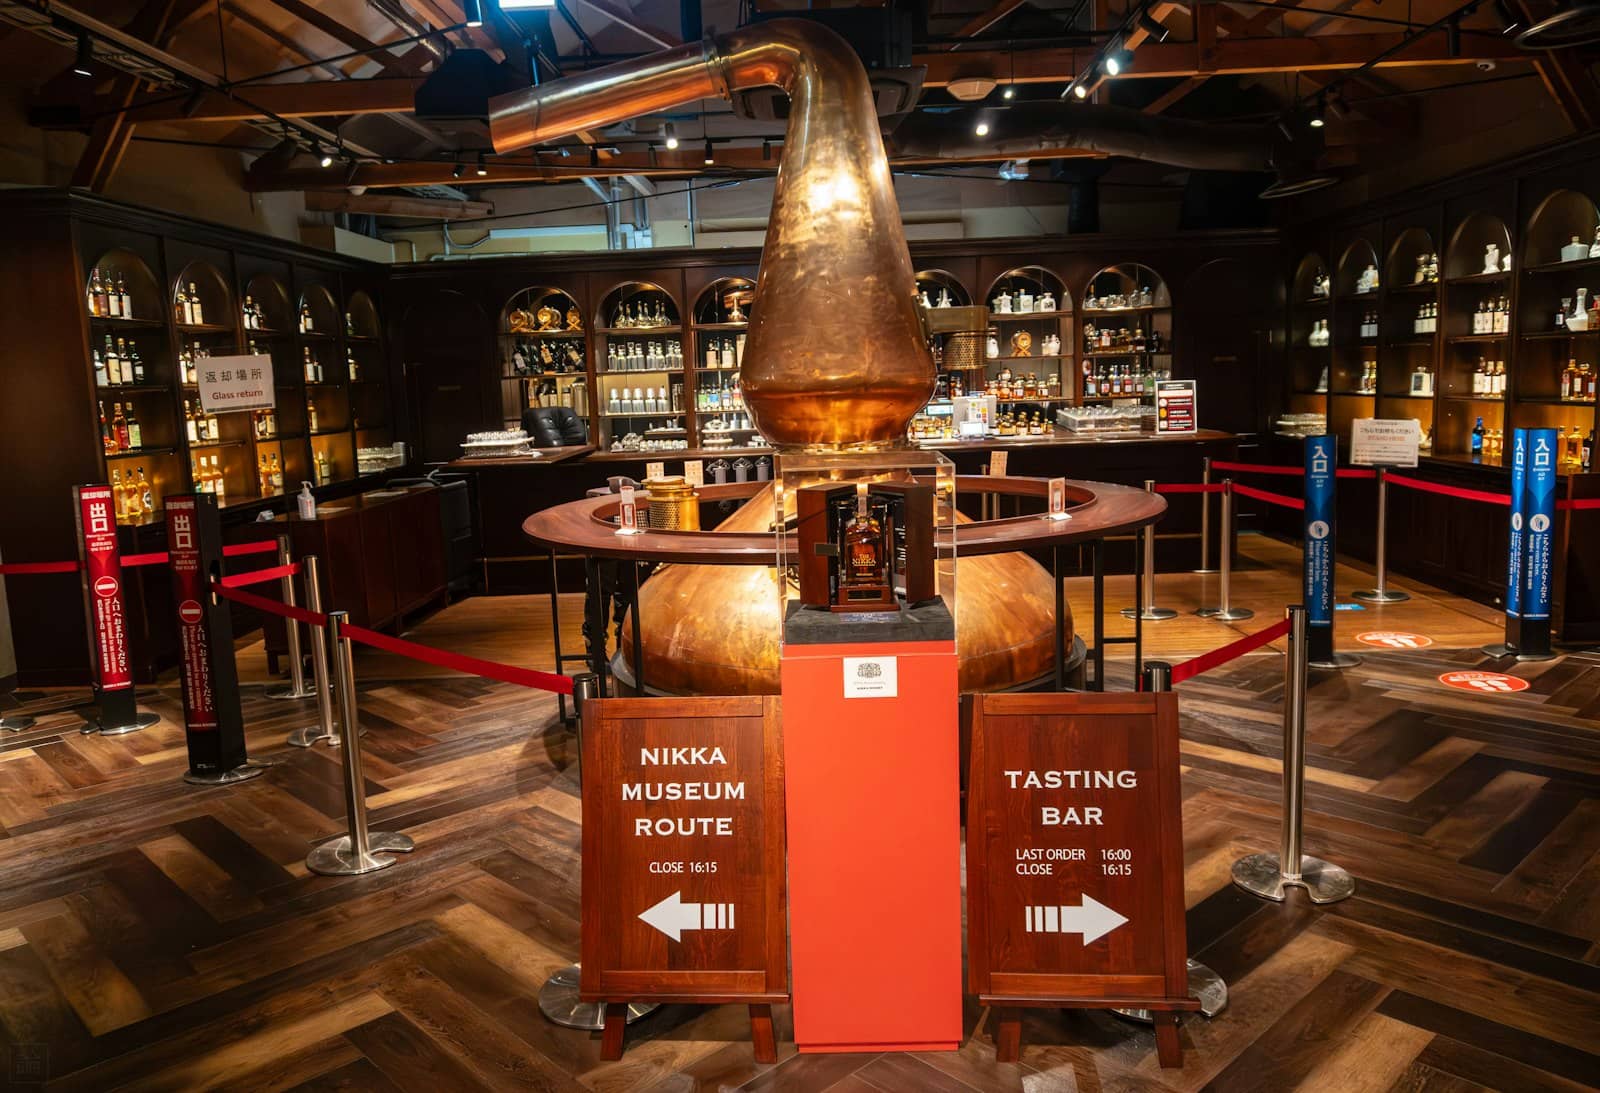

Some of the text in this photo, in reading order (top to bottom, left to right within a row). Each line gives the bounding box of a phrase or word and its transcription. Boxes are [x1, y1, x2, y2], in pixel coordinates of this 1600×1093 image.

[205, 368, 262, 383] 返却場所
[212, 390, 263, 400] Glass return
[1312, 445, 1328, 473] 入口
[1515, 437, 1524, 466] 入口
[1535, 438, 1550, 466] 入口
[90, 502, 108, 532] 出口
[174, 514, 192, 549] 出口
[112, 597, 128, 674] 入口へおまわりください
[640, 747, 727, 766] NIKKA
[1004, 770, 1138, 789] TASTING
[622, 781, 745, 801] MUSEUM
[1041, 806, 1104, 825] BAR
[634, 817, 733, 837] ROUTE
[1015, 848, 1132, 861] LAST ORDER 16:00
[649, 861, 718, 873] CLOSE 16:15
[1015, 863, 1132, 876] CLOSE 16:15
